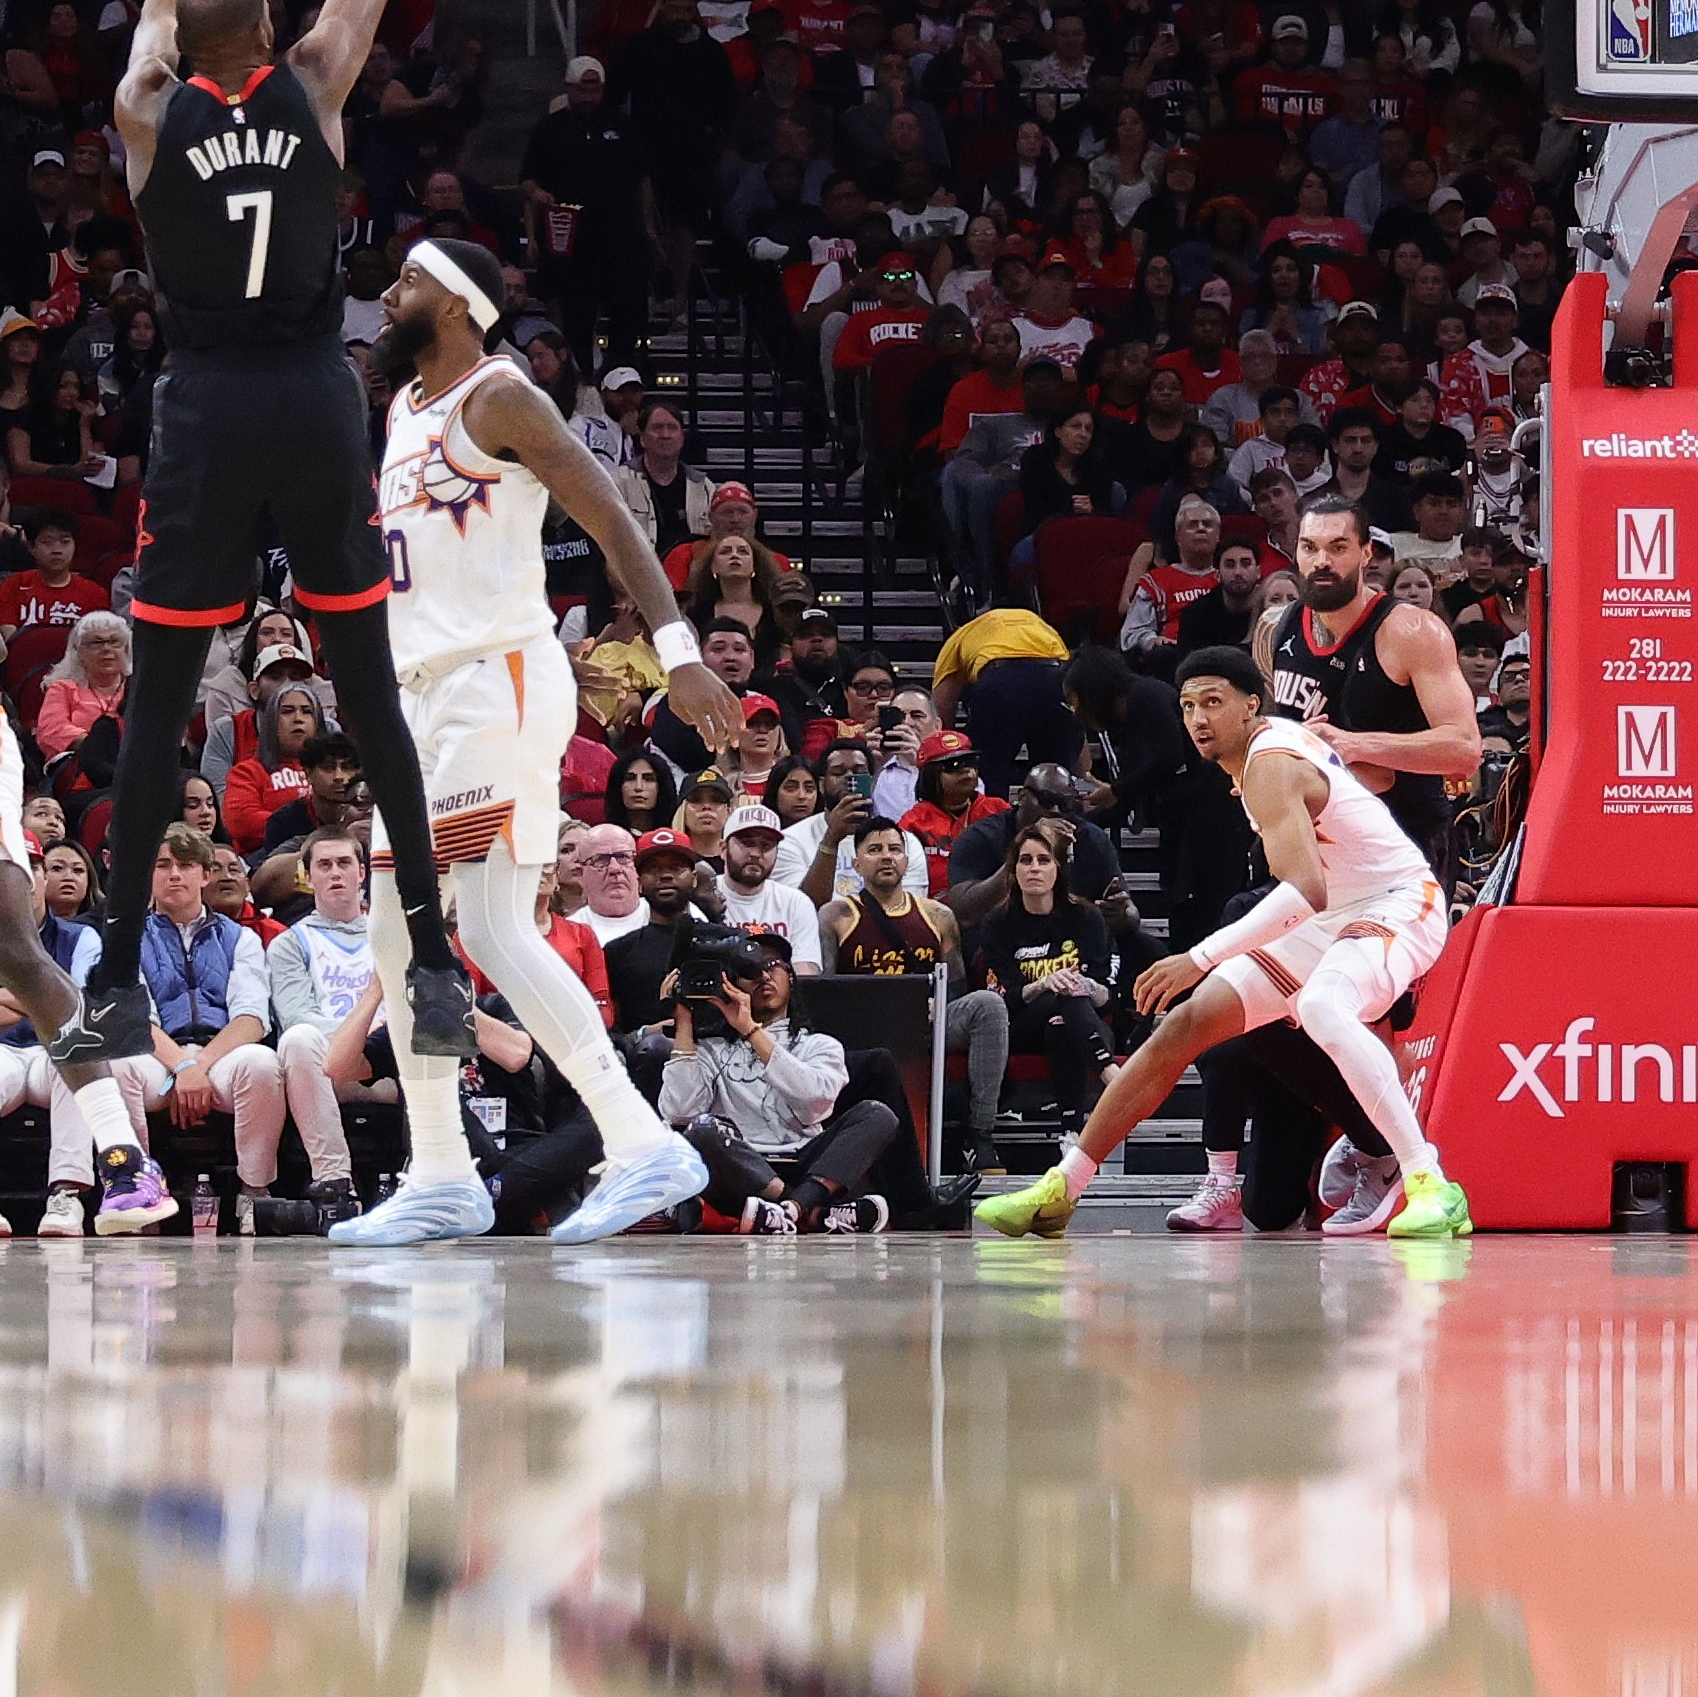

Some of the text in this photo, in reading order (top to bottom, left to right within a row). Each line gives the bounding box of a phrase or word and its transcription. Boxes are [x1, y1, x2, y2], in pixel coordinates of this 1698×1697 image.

[1614, 38, 1635, 55] NBA
[186, 128, 301, 181] DURANT
[226, 190, 274, 299] 7
[869, 323, 923, 346] ROCKE
[1582, 433, 1676, 459] reliant
[1623, 513, 1668, 575] M
[385, 529, 412, 593] 0
[1602, 588, 1692, 603] MOKARAM
[1602, 606, 1692, 618] INJURY LAWYERS
[1602, 661, 1693, 682] 222-2222
[1624, 710, 1668, 772] M
[431, 784, 495, 815] PHOENIX
[1603, 784, 1693, 799] MOKARAM
[1603, 803, 1694, 815] INJURY LAWYERS
[651, 832, 675, 844] C
